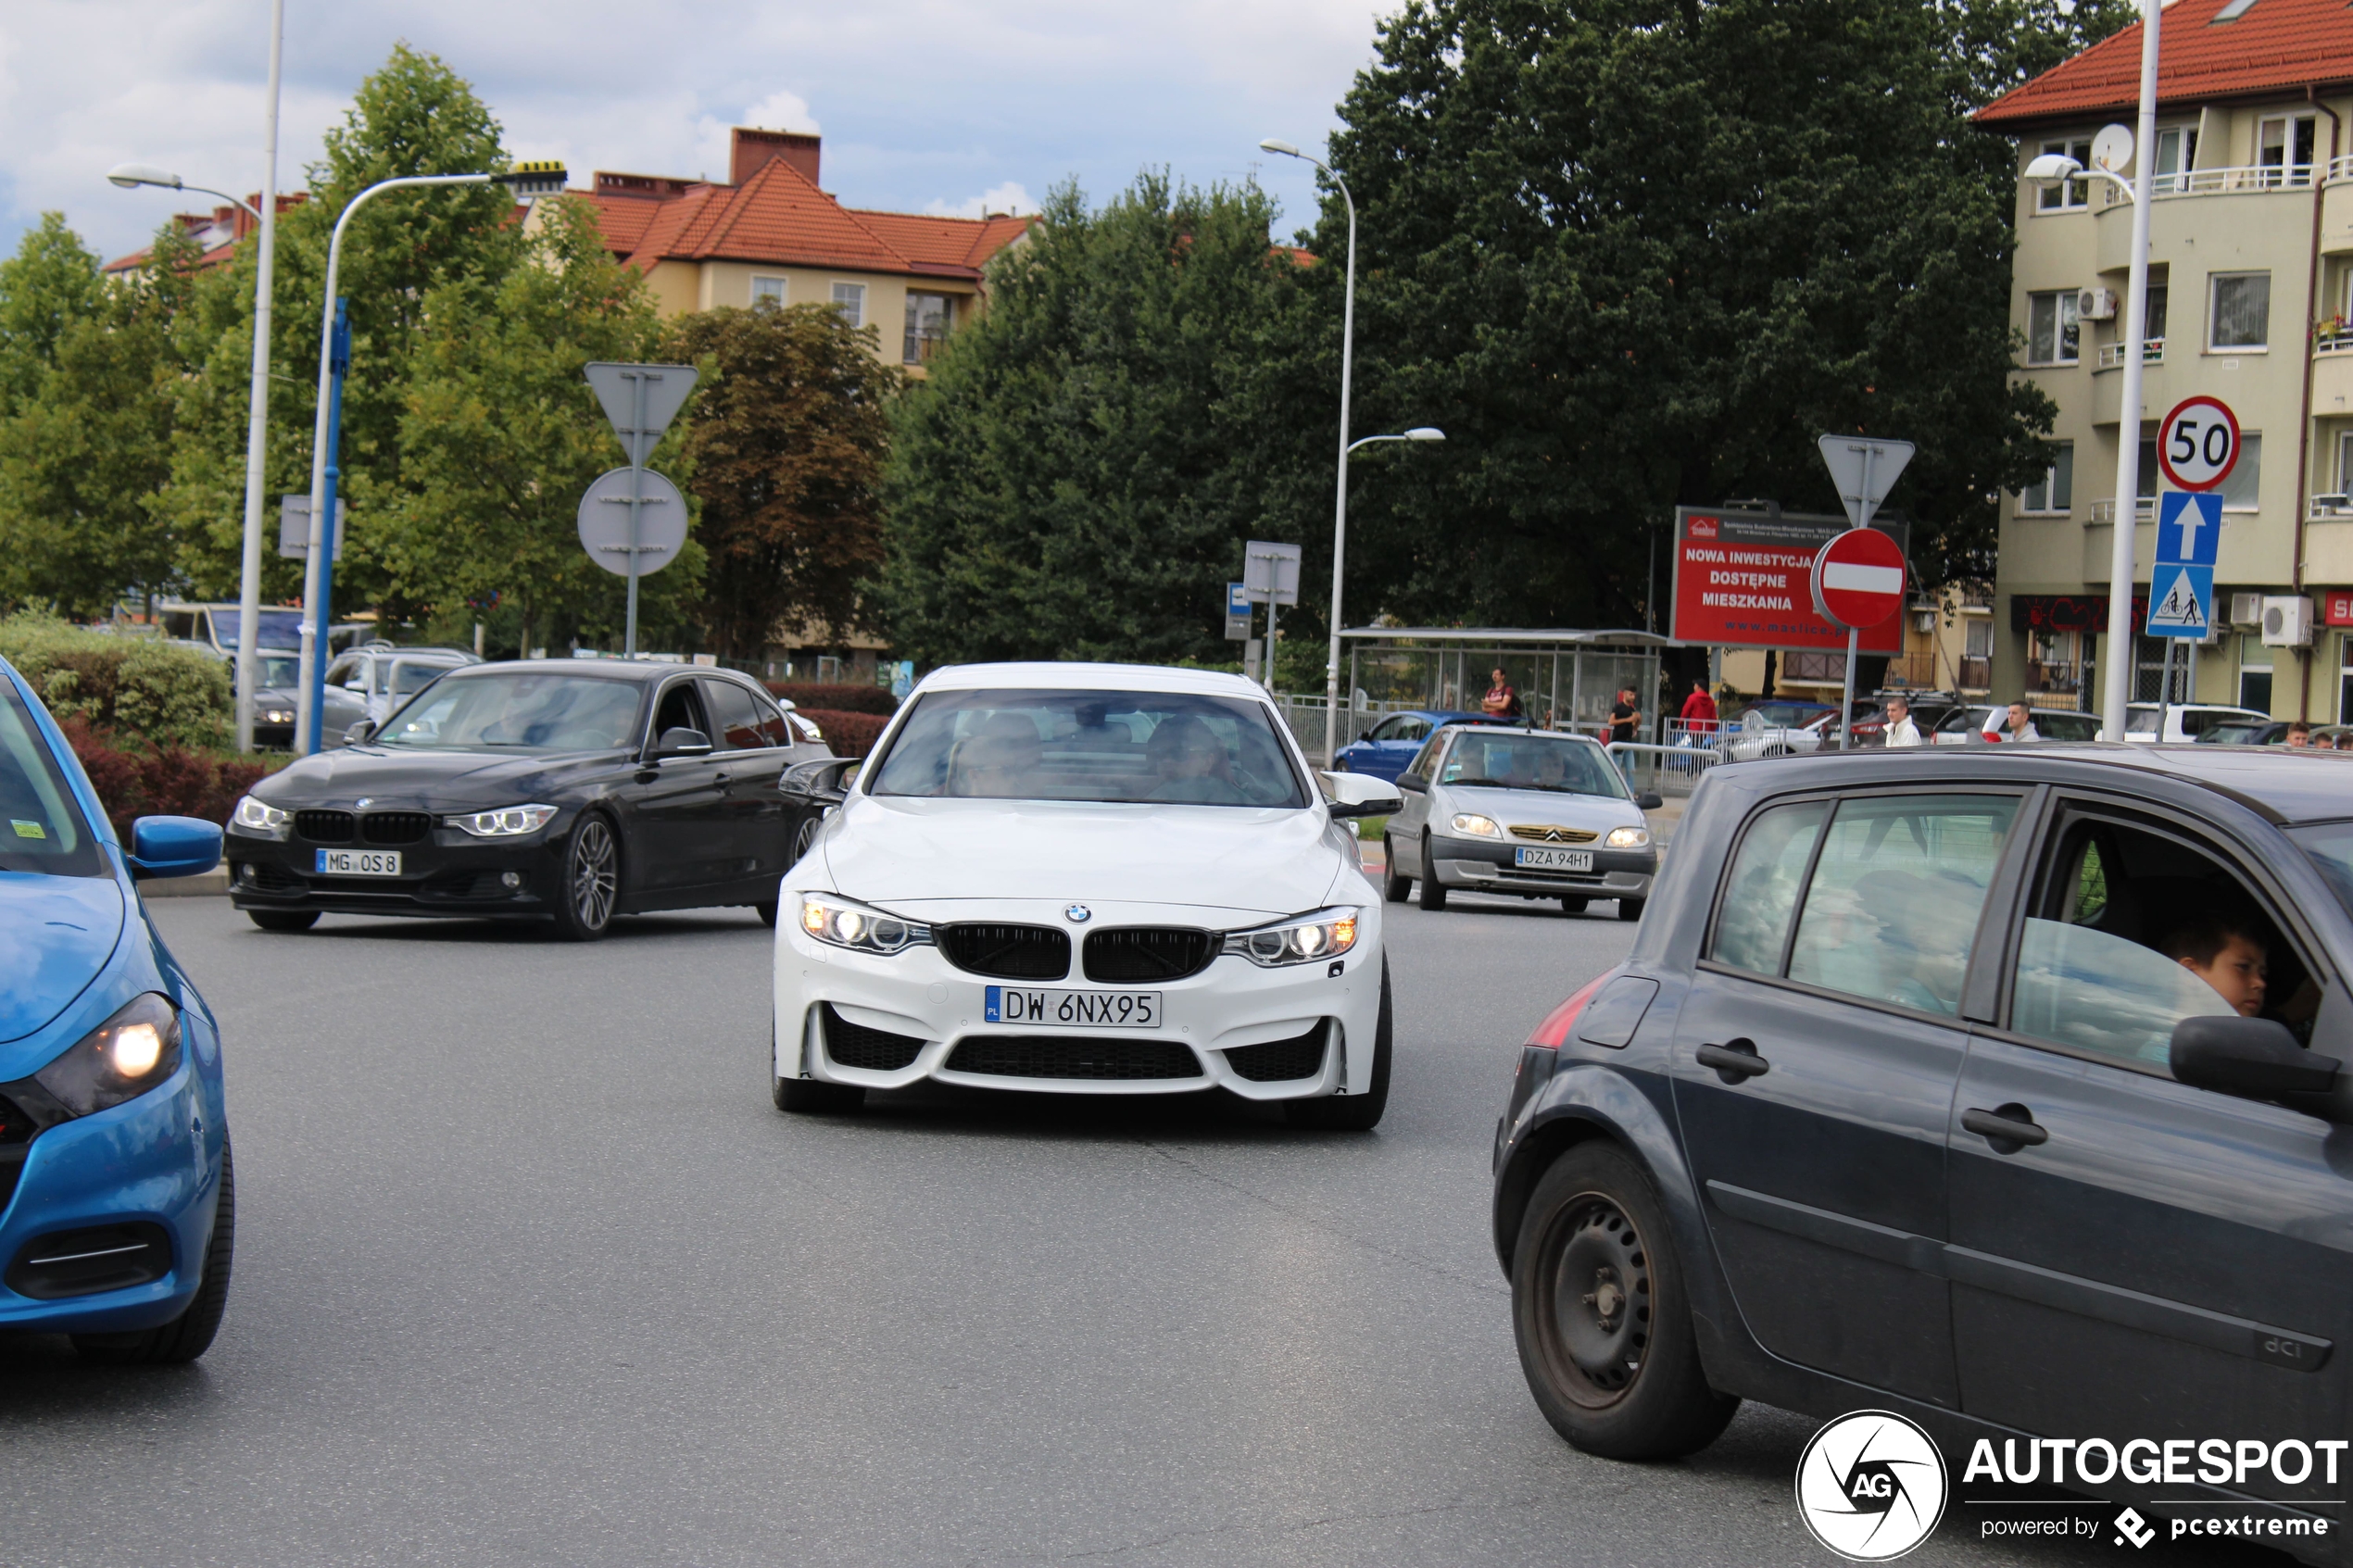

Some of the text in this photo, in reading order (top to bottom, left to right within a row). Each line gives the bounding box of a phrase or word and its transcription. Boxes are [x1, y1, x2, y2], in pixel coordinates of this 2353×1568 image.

[2171, 420, 2230, 467] 50
[1686, 548, 1812, 569] NOWA INWESTYCJA
[1710, 571, 1787, 590] DOSTĘPNE
[1702, 592, 1793, 611] MIESZKANIA
[329, 854, 349, 871] MG
[386, 856, 396, 872] 8
[1525, 850, 1588, 867] DZA 94H1
[988, 1008, 998, 1016] PL
[1006, 991, 1152, 1023] DW 6NX95
